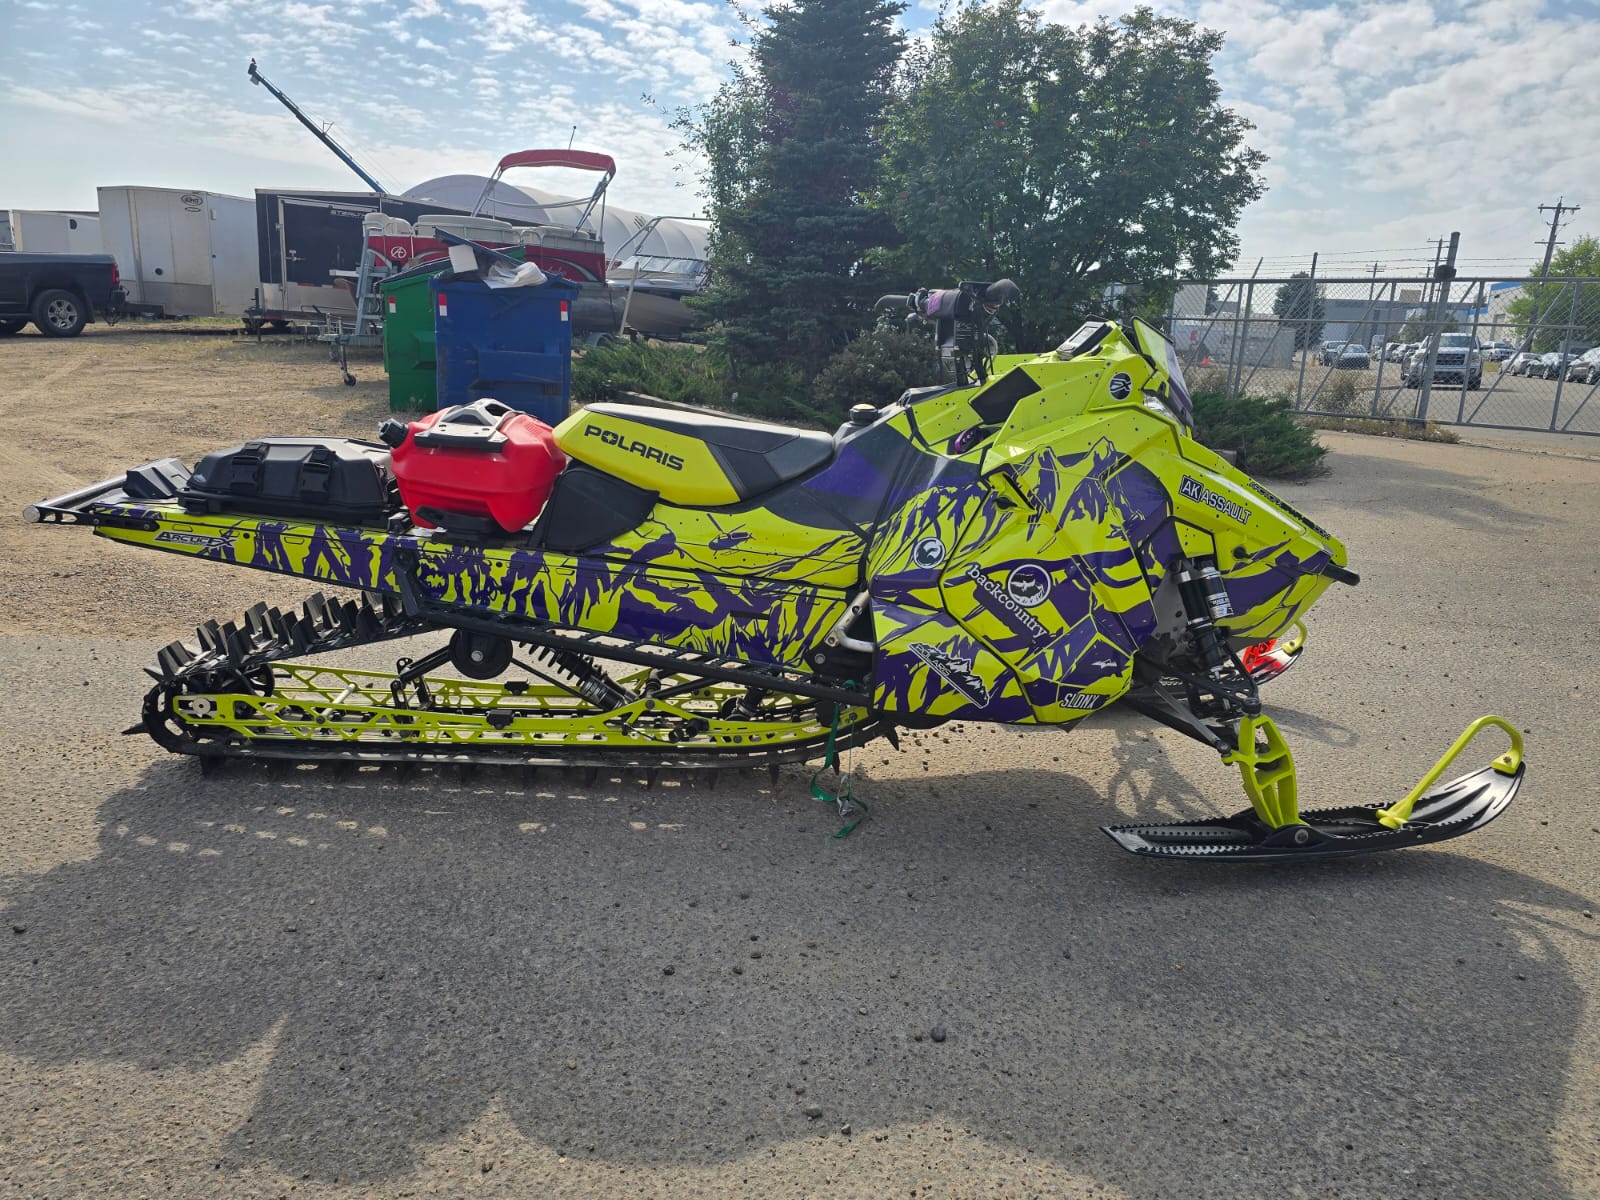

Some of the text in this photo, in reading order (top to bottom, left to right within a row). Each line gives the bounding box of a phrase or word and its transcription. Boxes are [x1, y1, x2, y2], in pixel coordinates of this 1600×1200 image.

[584, 424, 685, 471] POLARIS
[1181, 480, 1201, 499] AK
[1200, 489, 1252, 525] ASSAULT
[967, 563, 1048, 638] backcountry
[915, 643, 952, 676] POLARIS
